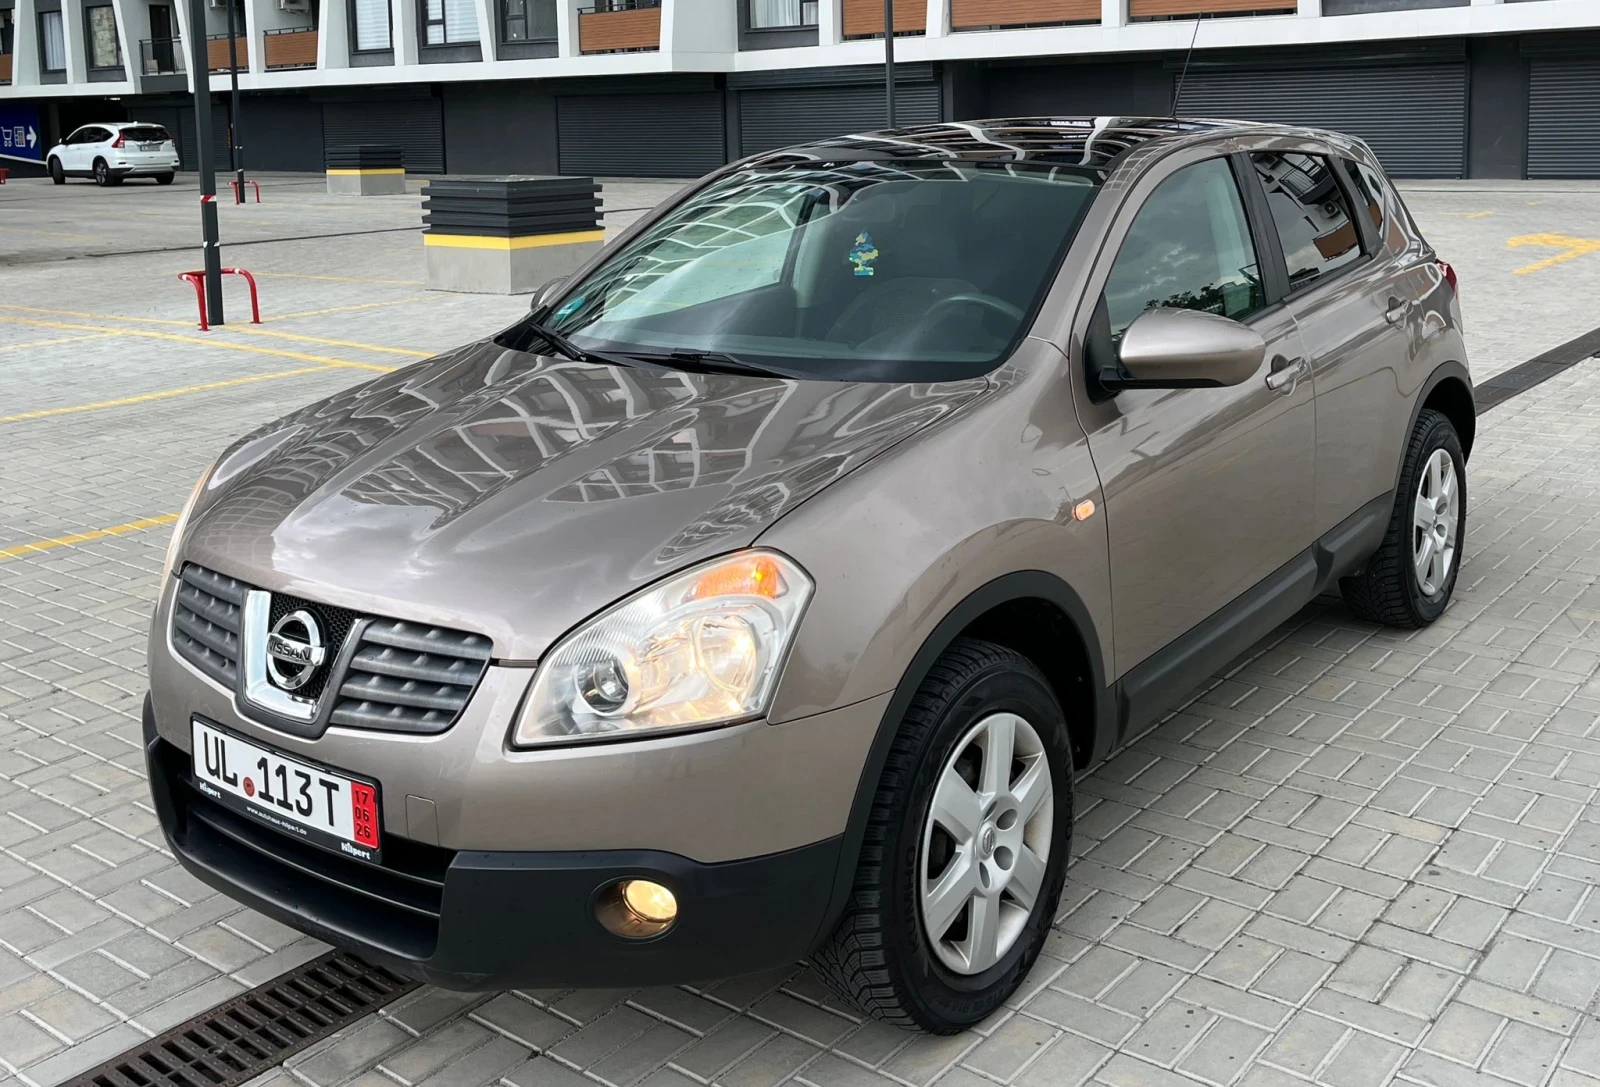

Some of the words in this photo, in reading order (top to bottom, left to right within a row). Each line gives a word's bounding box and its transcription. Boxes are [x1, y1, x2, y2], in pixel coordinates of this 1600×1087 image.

[203, 732, 238, 787] UL
[257, 756, 340, 827] 113T
[355, 789, 369, 805] 17
[355, 806, 370, 822] 06
[356, 823, 371, 838] 26
